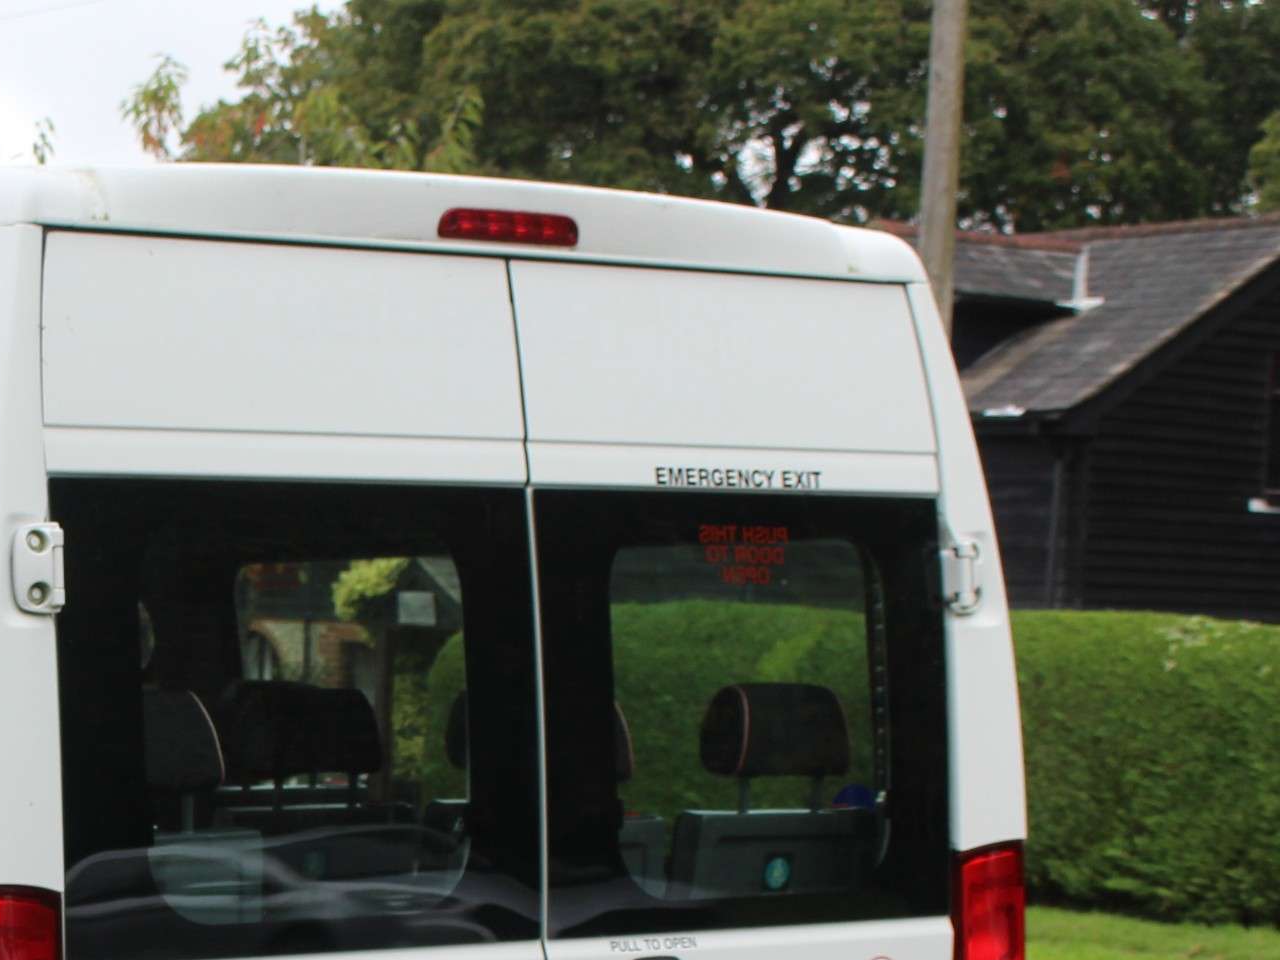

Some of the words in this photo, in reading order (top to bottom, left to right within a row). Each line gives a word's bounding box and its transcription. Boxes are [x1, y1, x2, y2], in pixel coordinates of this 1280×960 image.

[655, 466, 774, 488] EMERGENCY
[782, 470, 822, 489] EXIT
[610, 940, 641, 952] PULL
[644, 938, 661, 951] TO
[664, 936, 697, 950] OPEN
